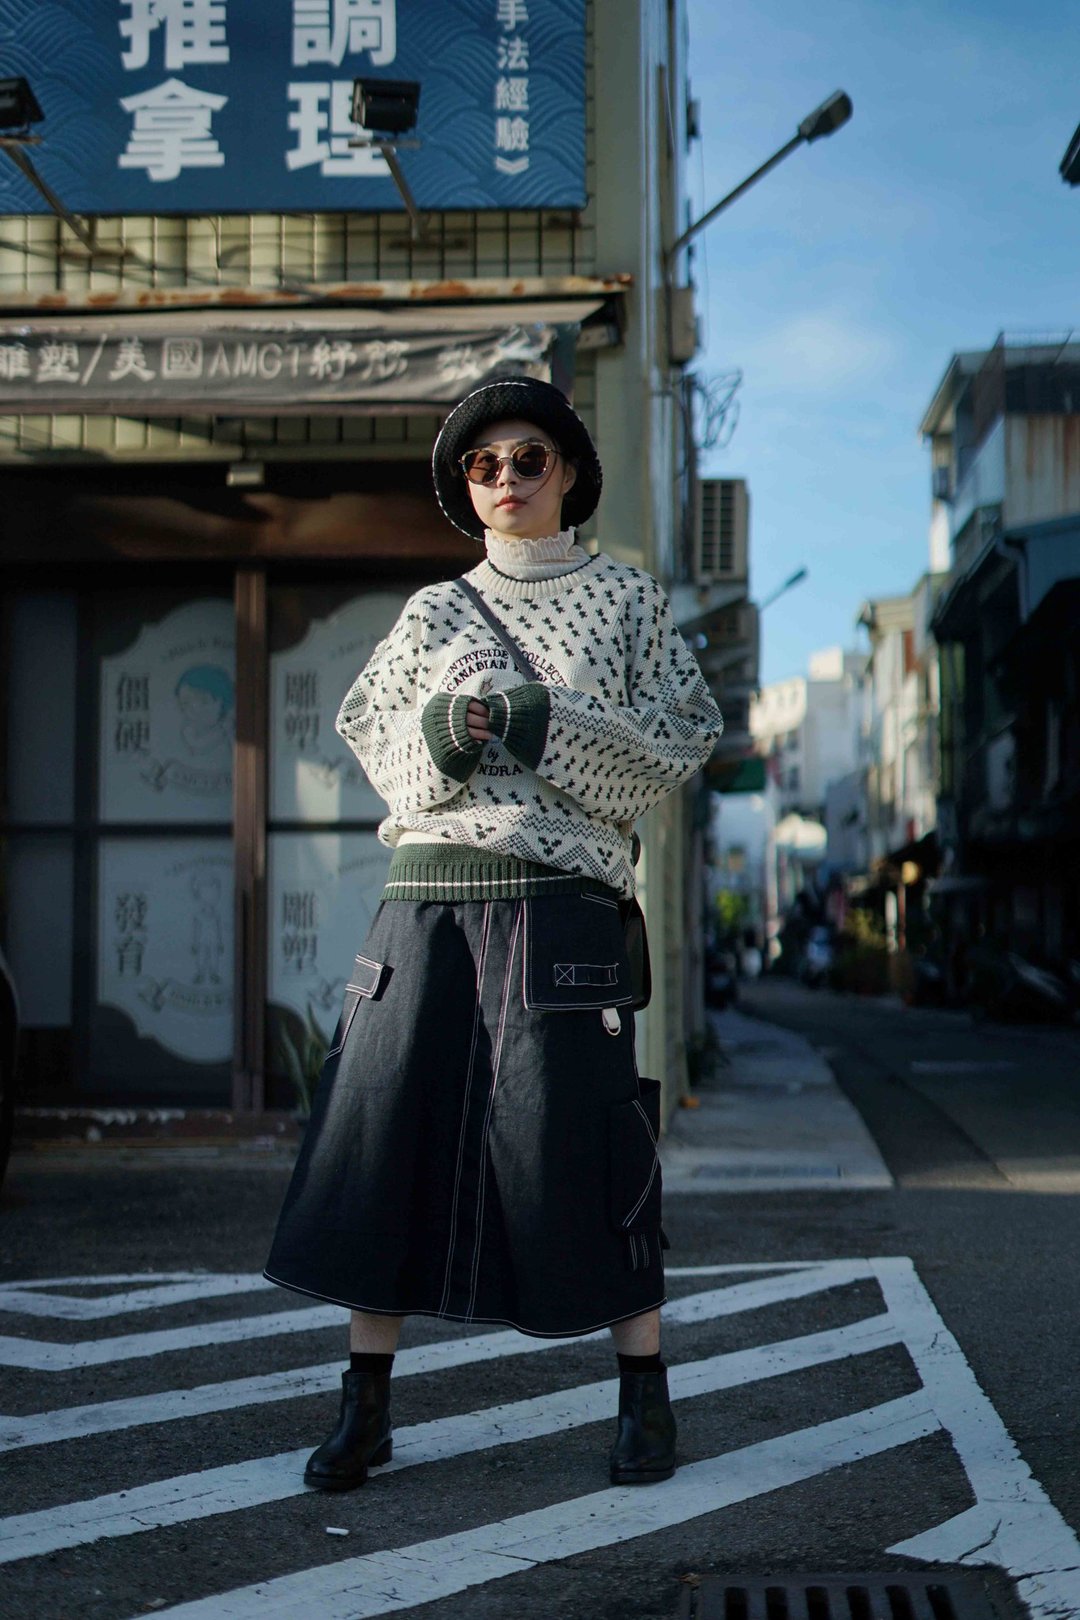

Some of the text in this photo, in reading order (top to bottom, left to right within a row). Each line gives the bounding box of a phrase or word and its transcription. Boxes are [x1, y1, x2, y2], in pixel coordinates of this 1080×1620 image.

[447, 660, 507, 692] CANADIAN
[521, 650, 567, 687] COLLECT
[487, 748, 499, 763] by
[477, 763, 523, 776] NDRA
